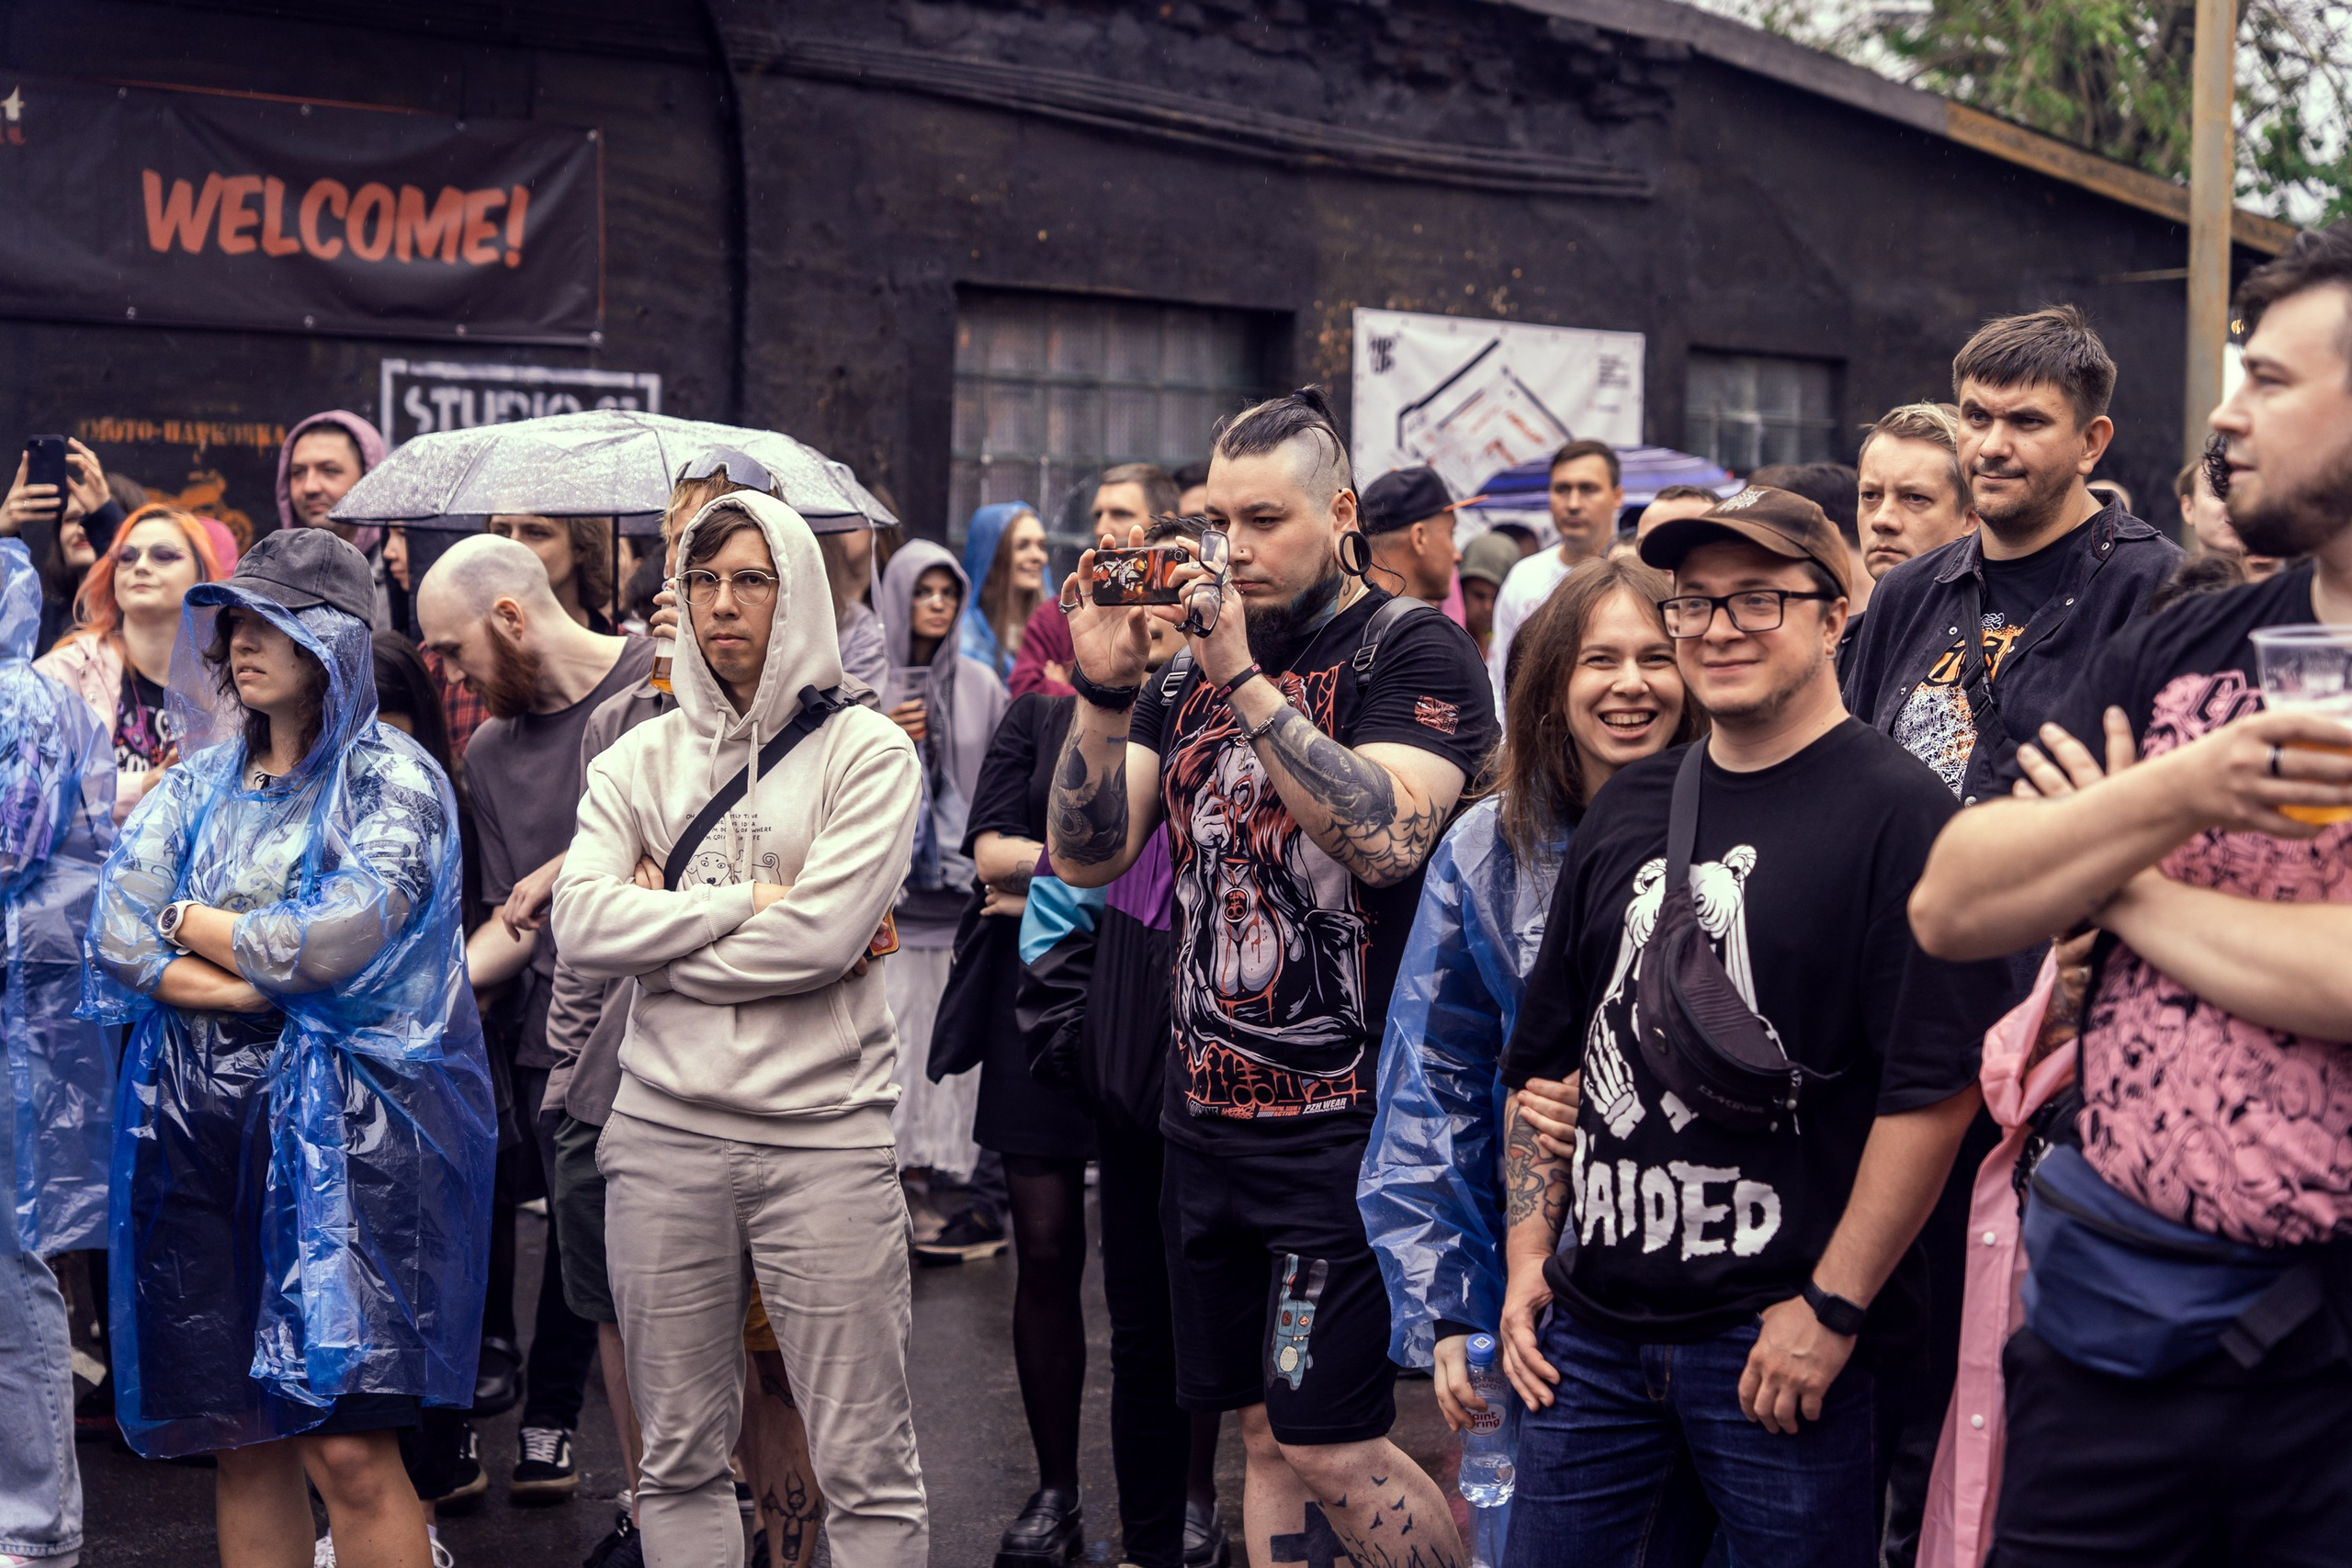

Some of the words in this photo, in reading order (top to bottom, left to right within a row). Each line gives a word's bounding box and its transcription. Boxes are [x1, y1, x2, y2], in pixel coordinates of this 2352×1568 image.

[142, 168, 529, 268] WELCOME!
[1323, 1097, 1347, 1109] WEAR
[1475, 1418, 1500, 1428] ring
